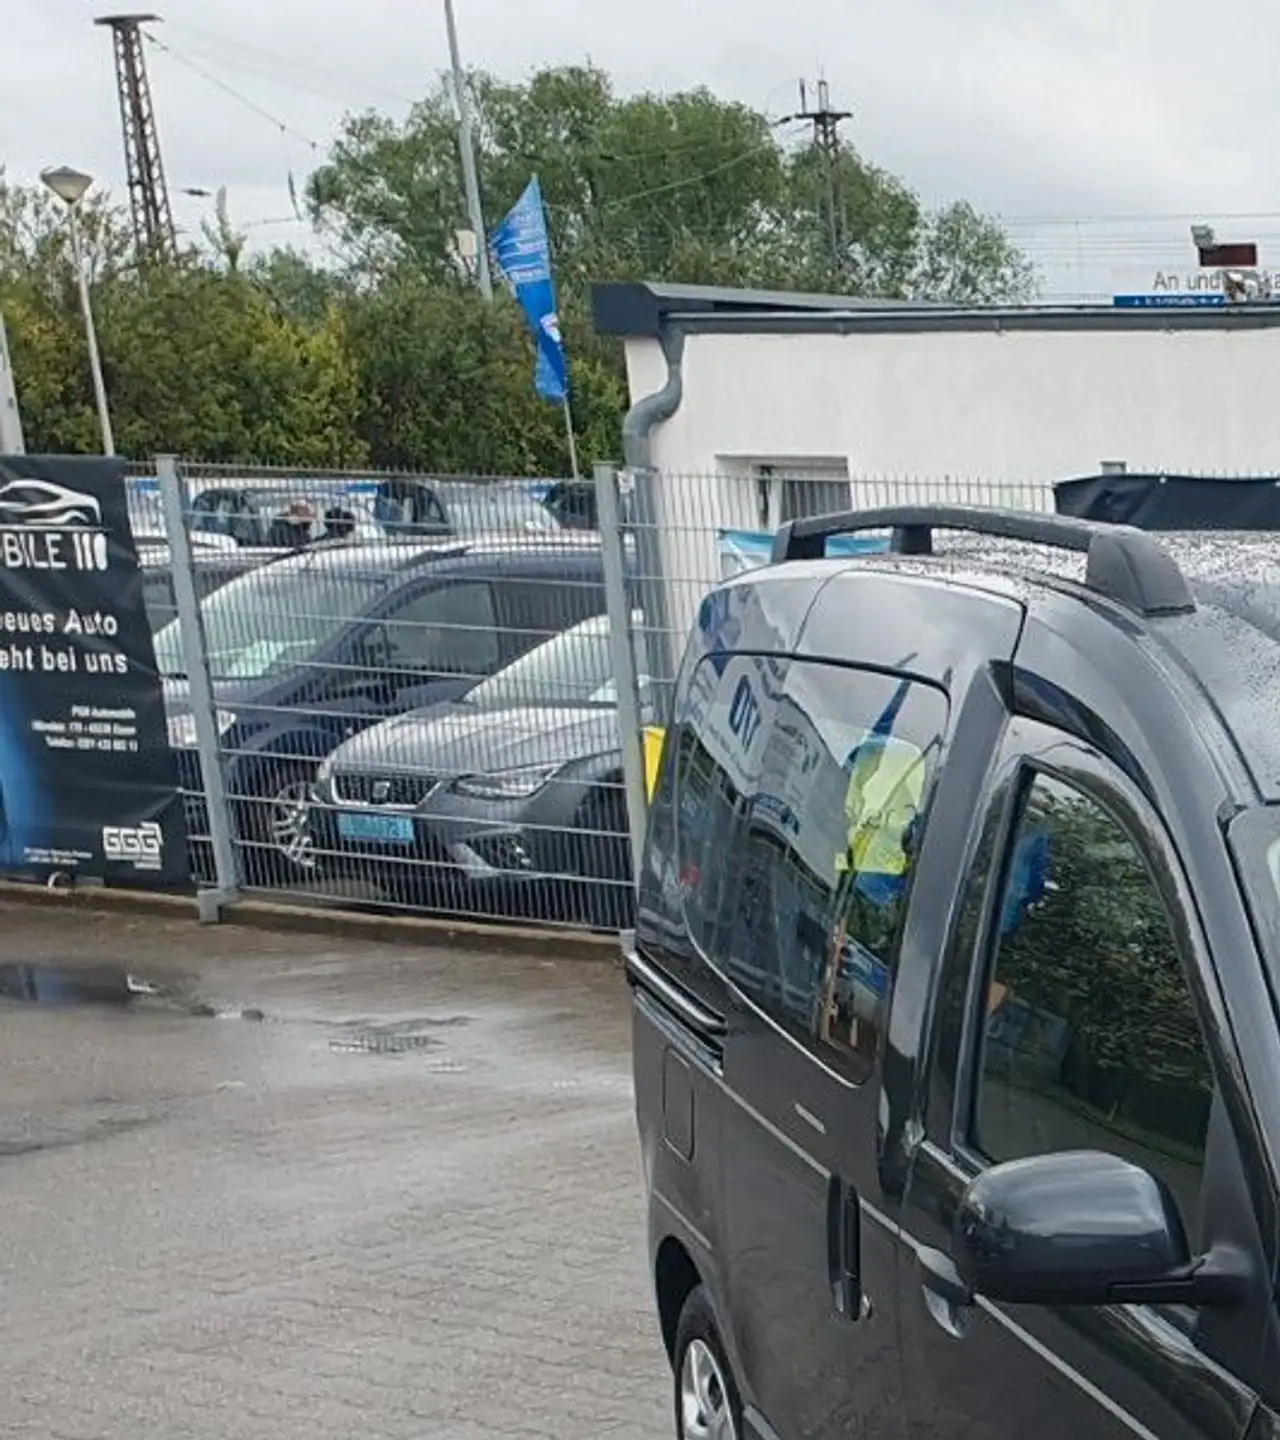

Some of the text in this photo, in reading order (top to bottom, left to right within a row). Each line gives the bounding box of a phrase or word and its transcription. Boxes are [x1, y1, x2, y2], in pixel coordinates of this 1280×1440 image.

[1152, 270, 1179, 290] An
[0, 531, 67, 569] BILE
[63, 607, 118, 636] Auto
[41, 643, 77, 672] bei
[84, 651, 129, 674] uns
